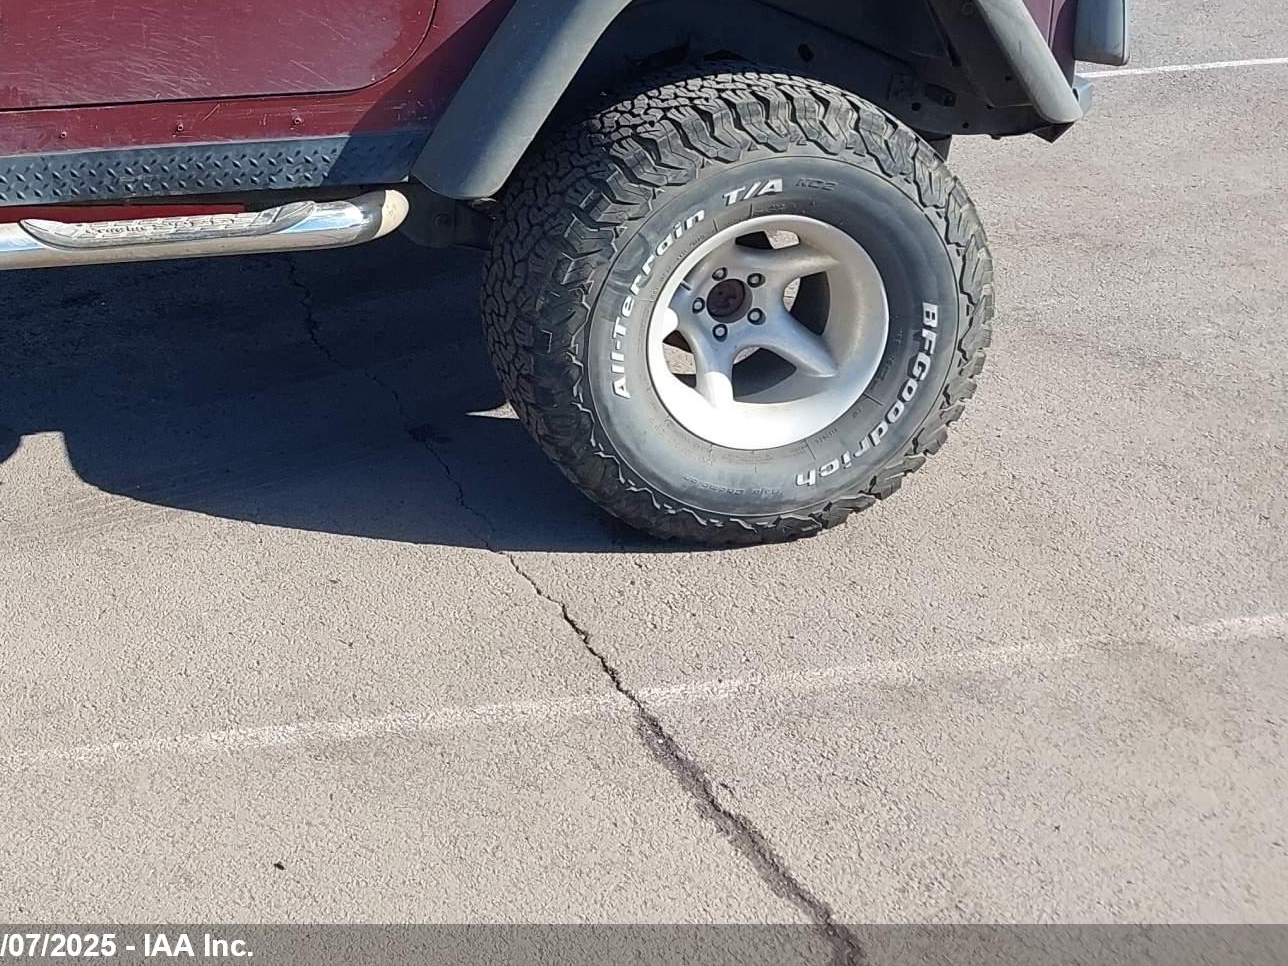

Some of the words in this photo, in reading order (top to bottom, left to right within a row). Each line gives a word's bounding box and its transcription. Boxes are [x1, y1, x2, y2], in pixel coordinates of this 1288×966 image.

[611, 208, 705, 400] All-Terrain
[722, 178, 784, 207] T/A
[793, 301, 940, 487] BFGoodrich
